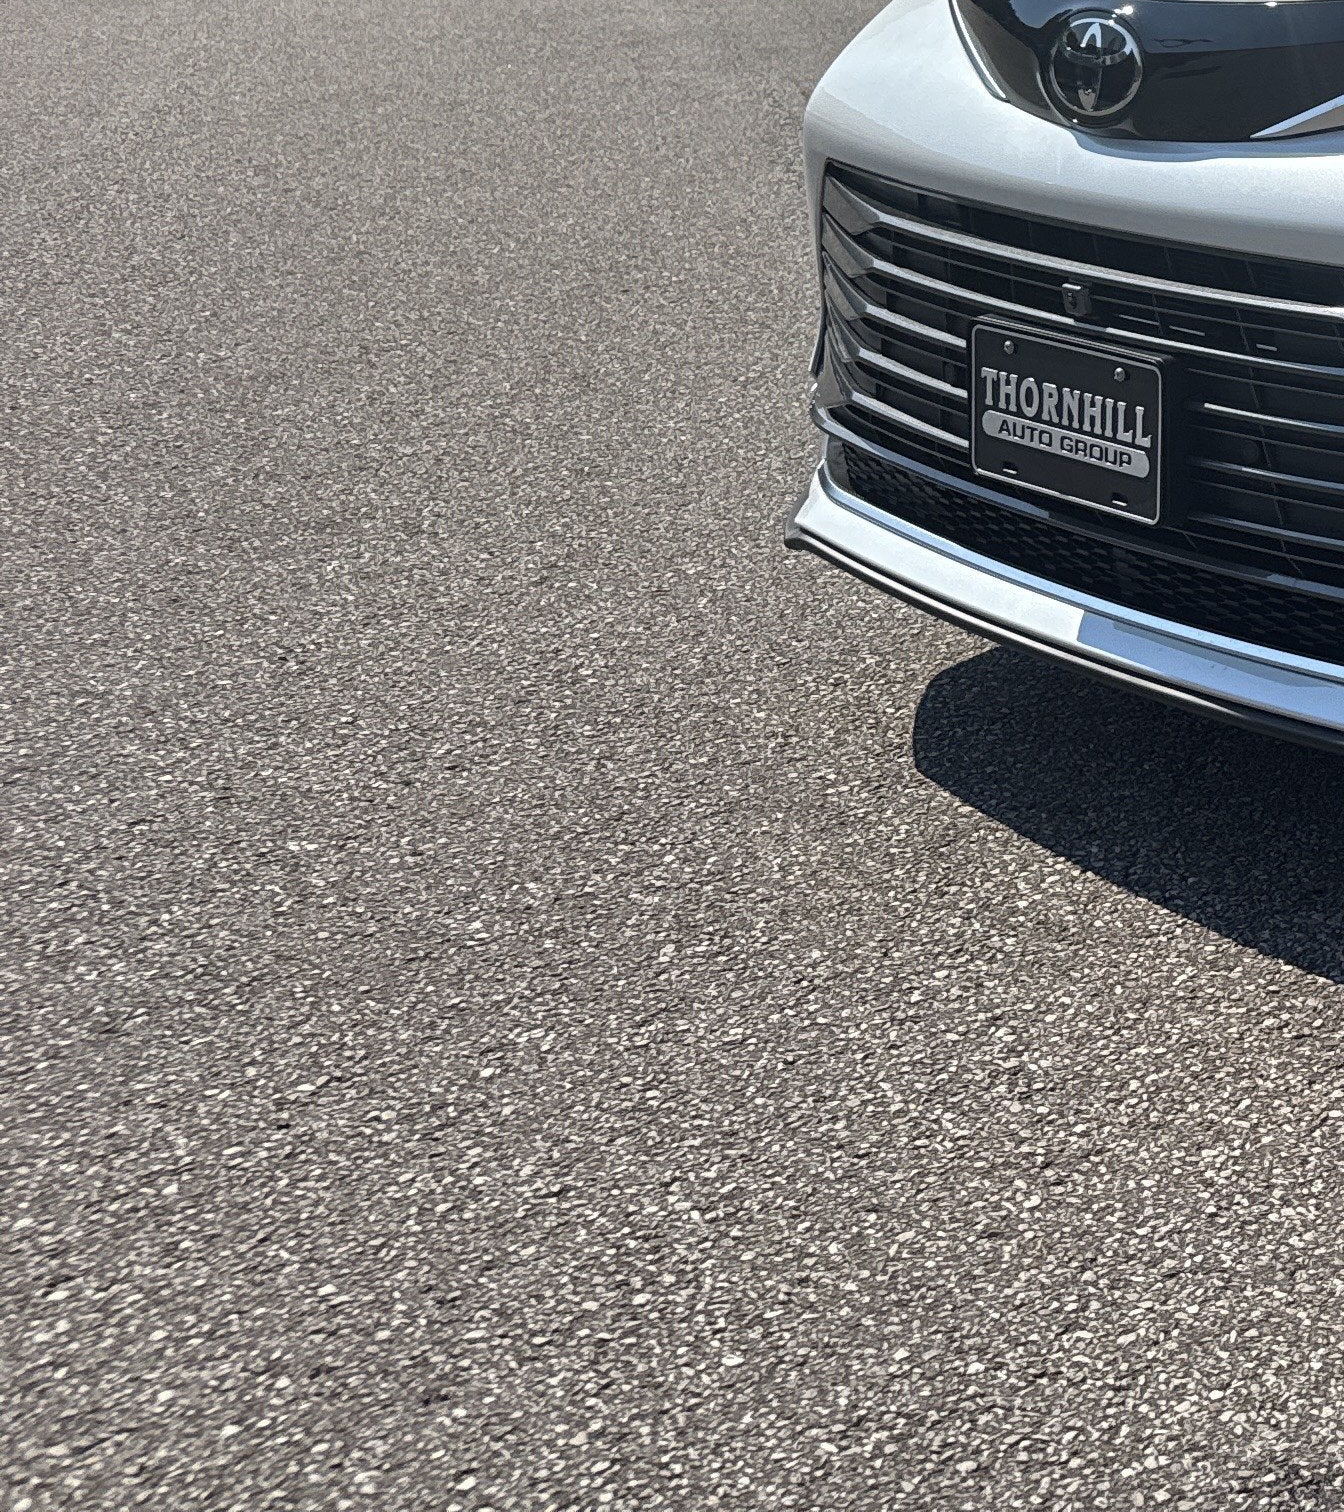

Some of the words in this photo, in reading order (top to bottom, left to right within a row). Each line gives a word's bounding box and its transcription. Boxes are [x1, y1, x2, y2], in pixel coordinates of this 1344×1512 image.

[981, 367, 1152, 448] THORNHILL
[998, 419, 1054, 448] AUTO
[1060, 435, 1132, 468] GROUP
